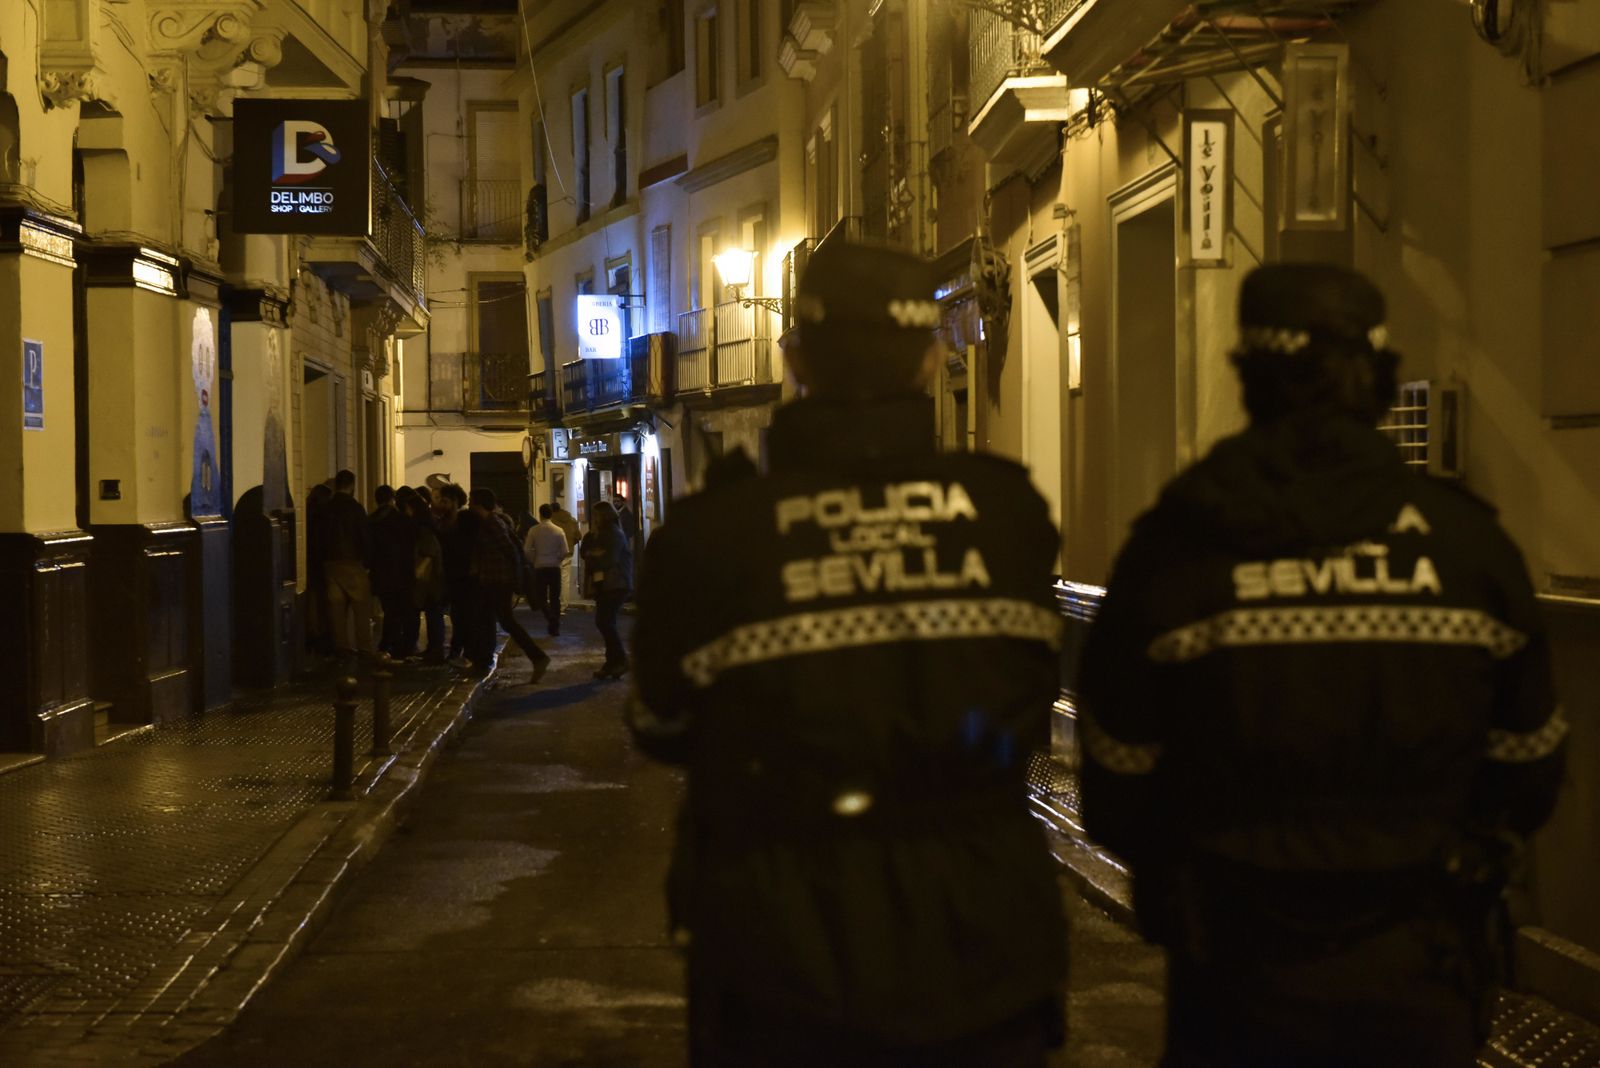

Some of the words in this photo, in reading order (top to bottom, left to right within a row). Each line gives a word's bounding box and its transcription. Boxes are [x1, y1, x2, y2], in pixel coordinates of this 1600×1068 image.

[271, 192, 334, 204] DELIMBO
[271, 205, 293, 213] SHOP
[299, 205, 333, 213] GALLERY
[776, 481, 979, 534] POLICIA
[829, 524, 936, 553] LOCAL
[782, 547, 991, 602] SEVILLA
[1232, 556, 1442, 601] SEVILLA
